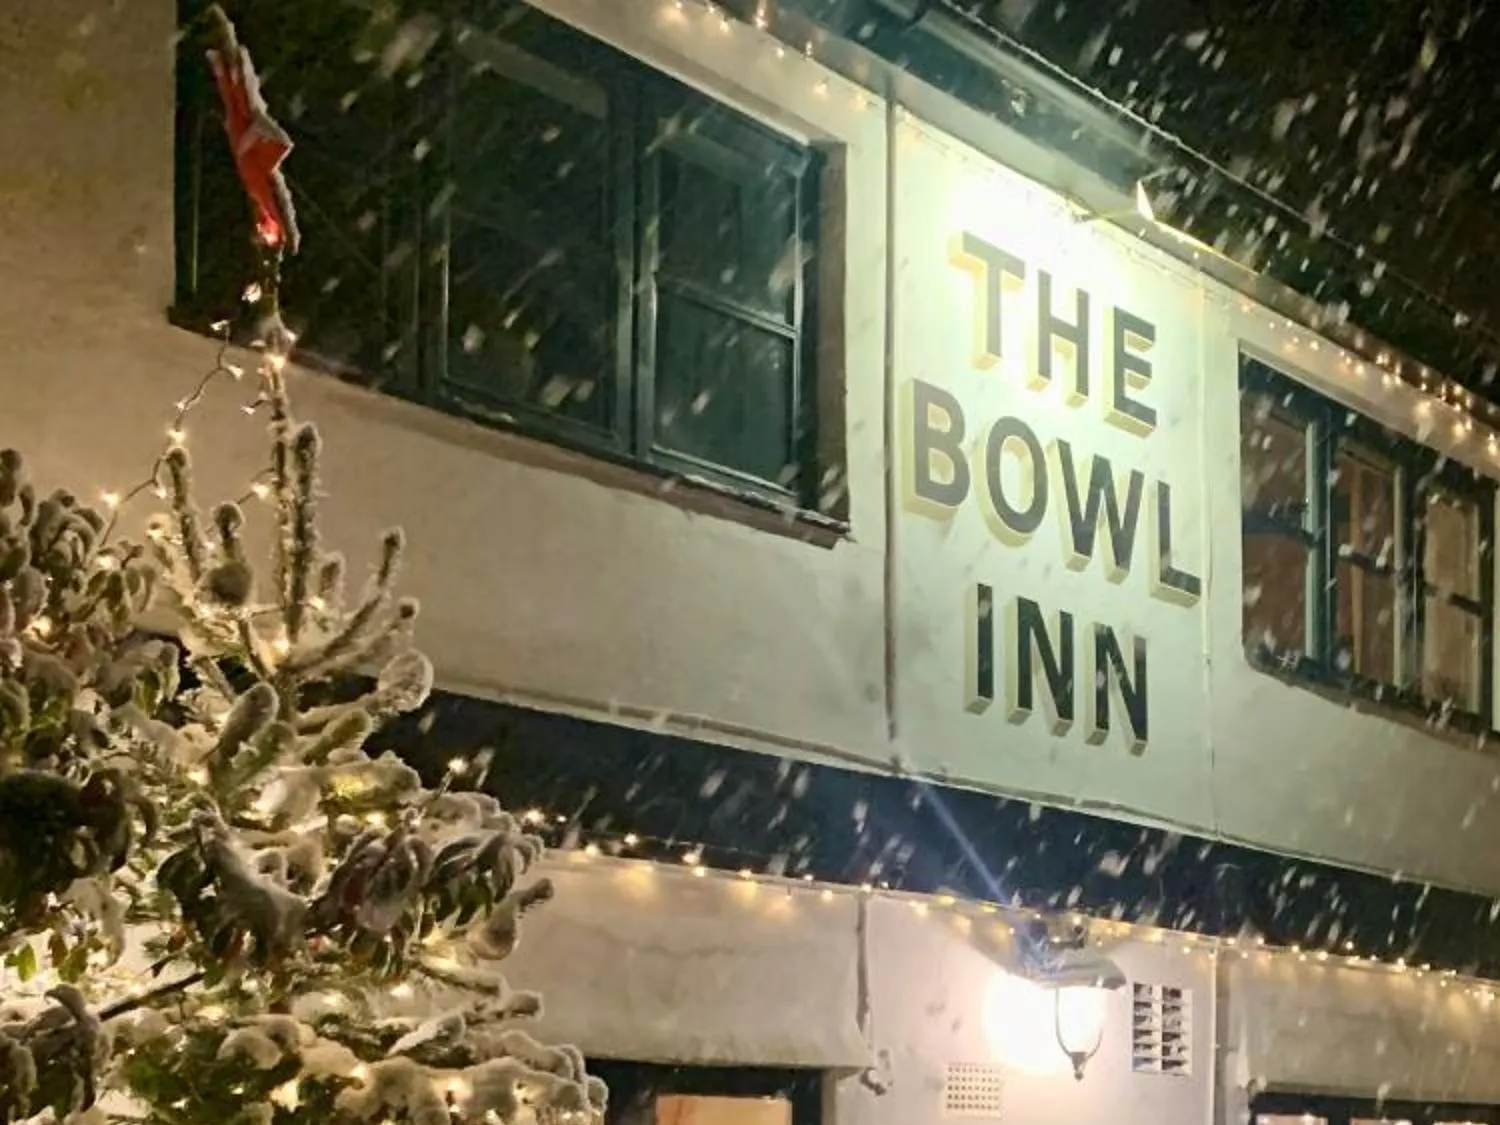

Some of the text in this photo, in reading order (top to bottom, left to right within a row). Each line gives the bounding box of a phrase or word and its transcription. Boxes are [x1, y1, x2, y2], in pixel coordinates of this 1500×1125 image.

[948, 230, 1157, 437] THE
[903, 378, 1201, 607] BOWL
[964, 583, 1148, 757] INN
